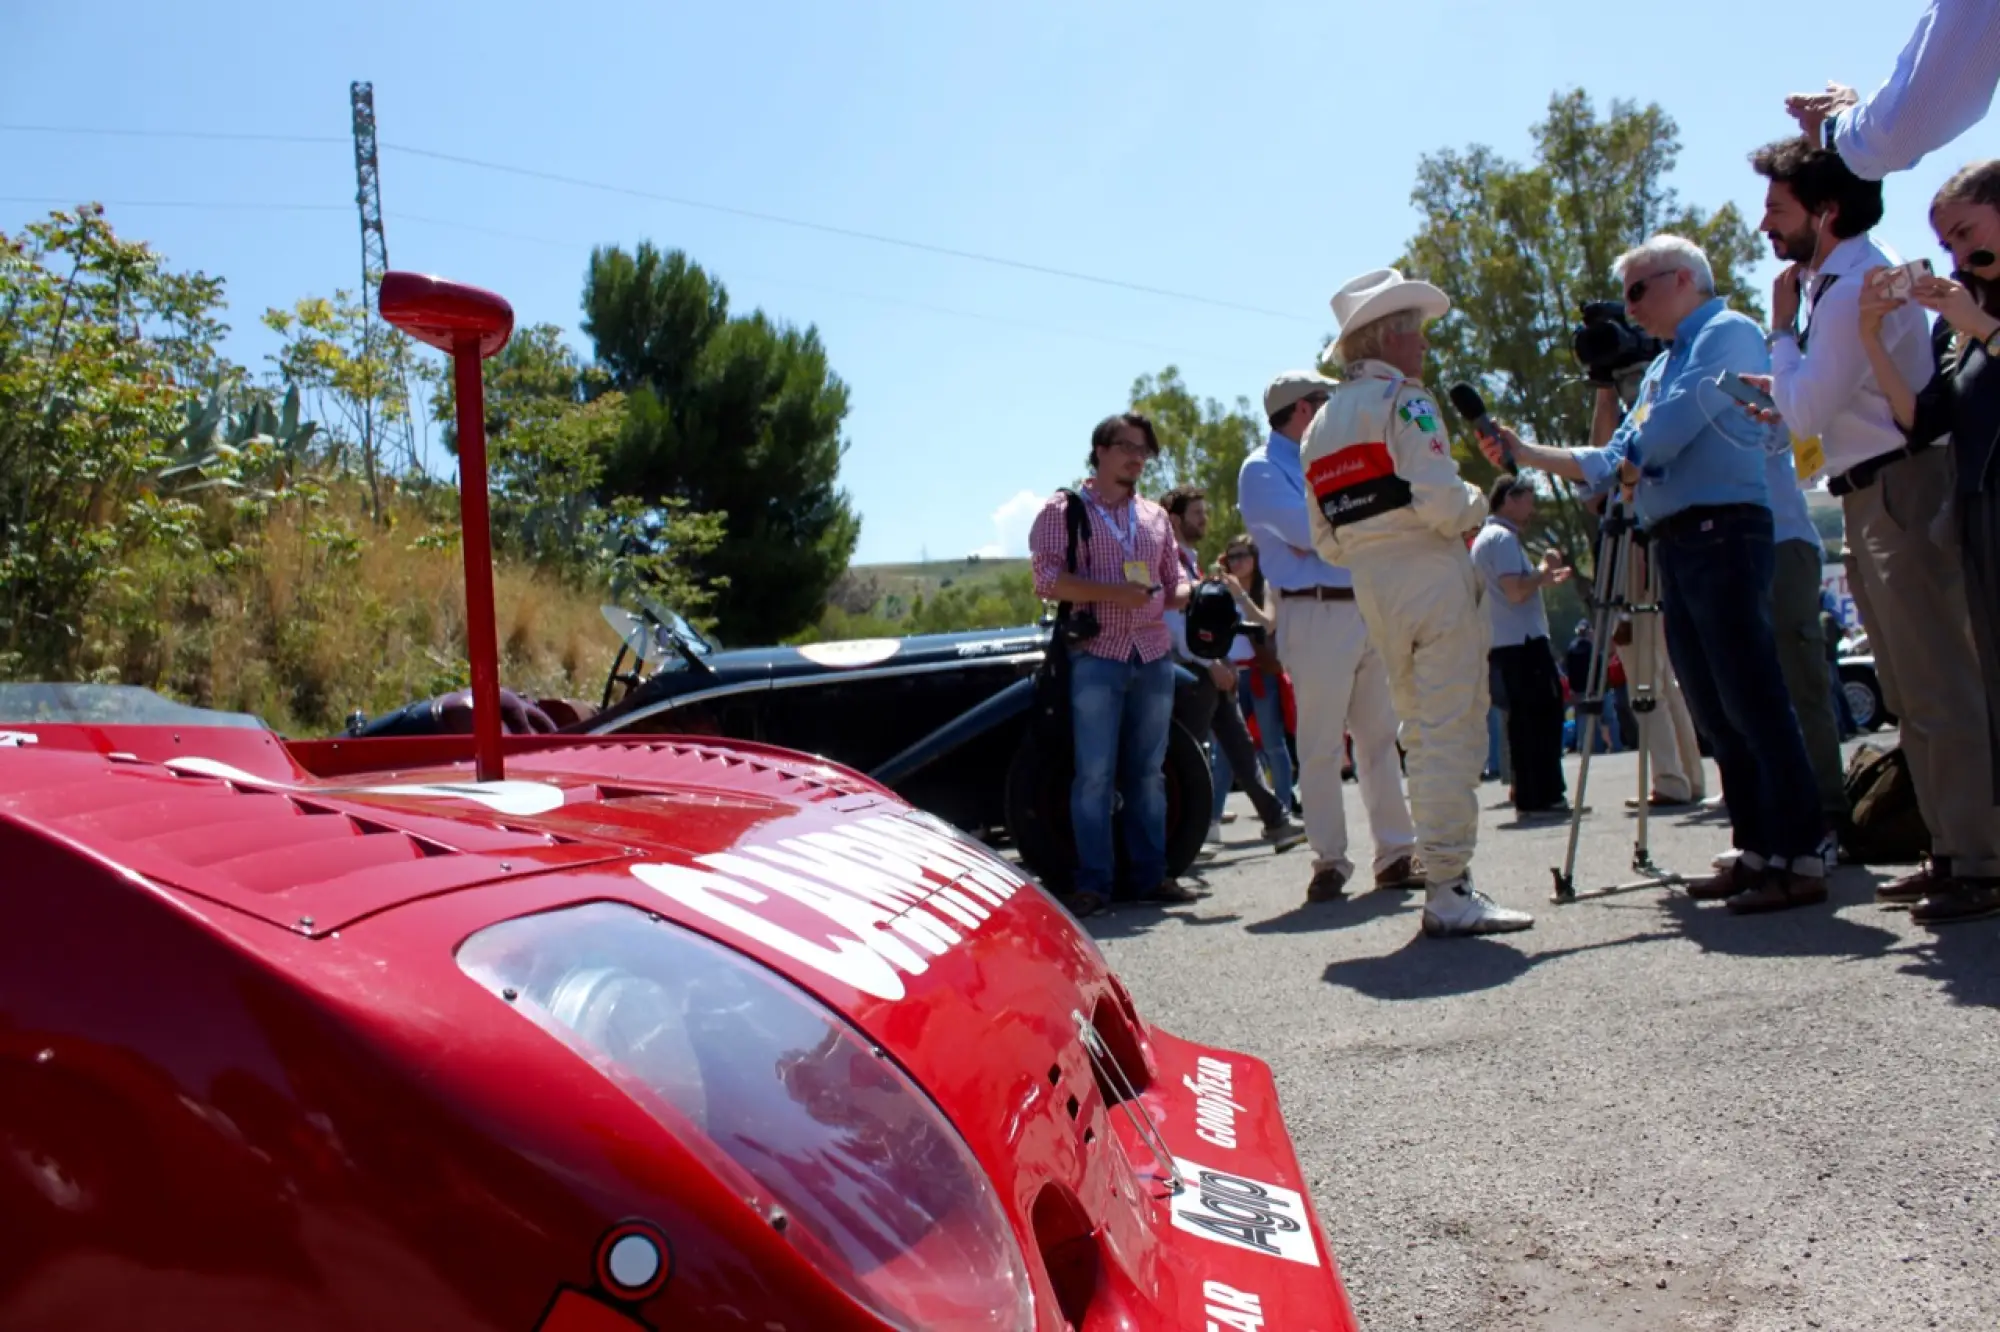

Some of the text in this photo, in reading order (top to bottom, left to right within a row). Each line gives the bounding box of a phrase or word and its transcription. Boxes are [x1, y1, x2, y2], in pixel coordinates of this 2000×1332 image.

[629, 811, 1026, 1000] CAMPARI
[1182, 1056, 1247, 1149] GOODYEAR
[1177, 1170, 1301, 1256] Agip
[1202, 1280, 1265, 1332] AR
